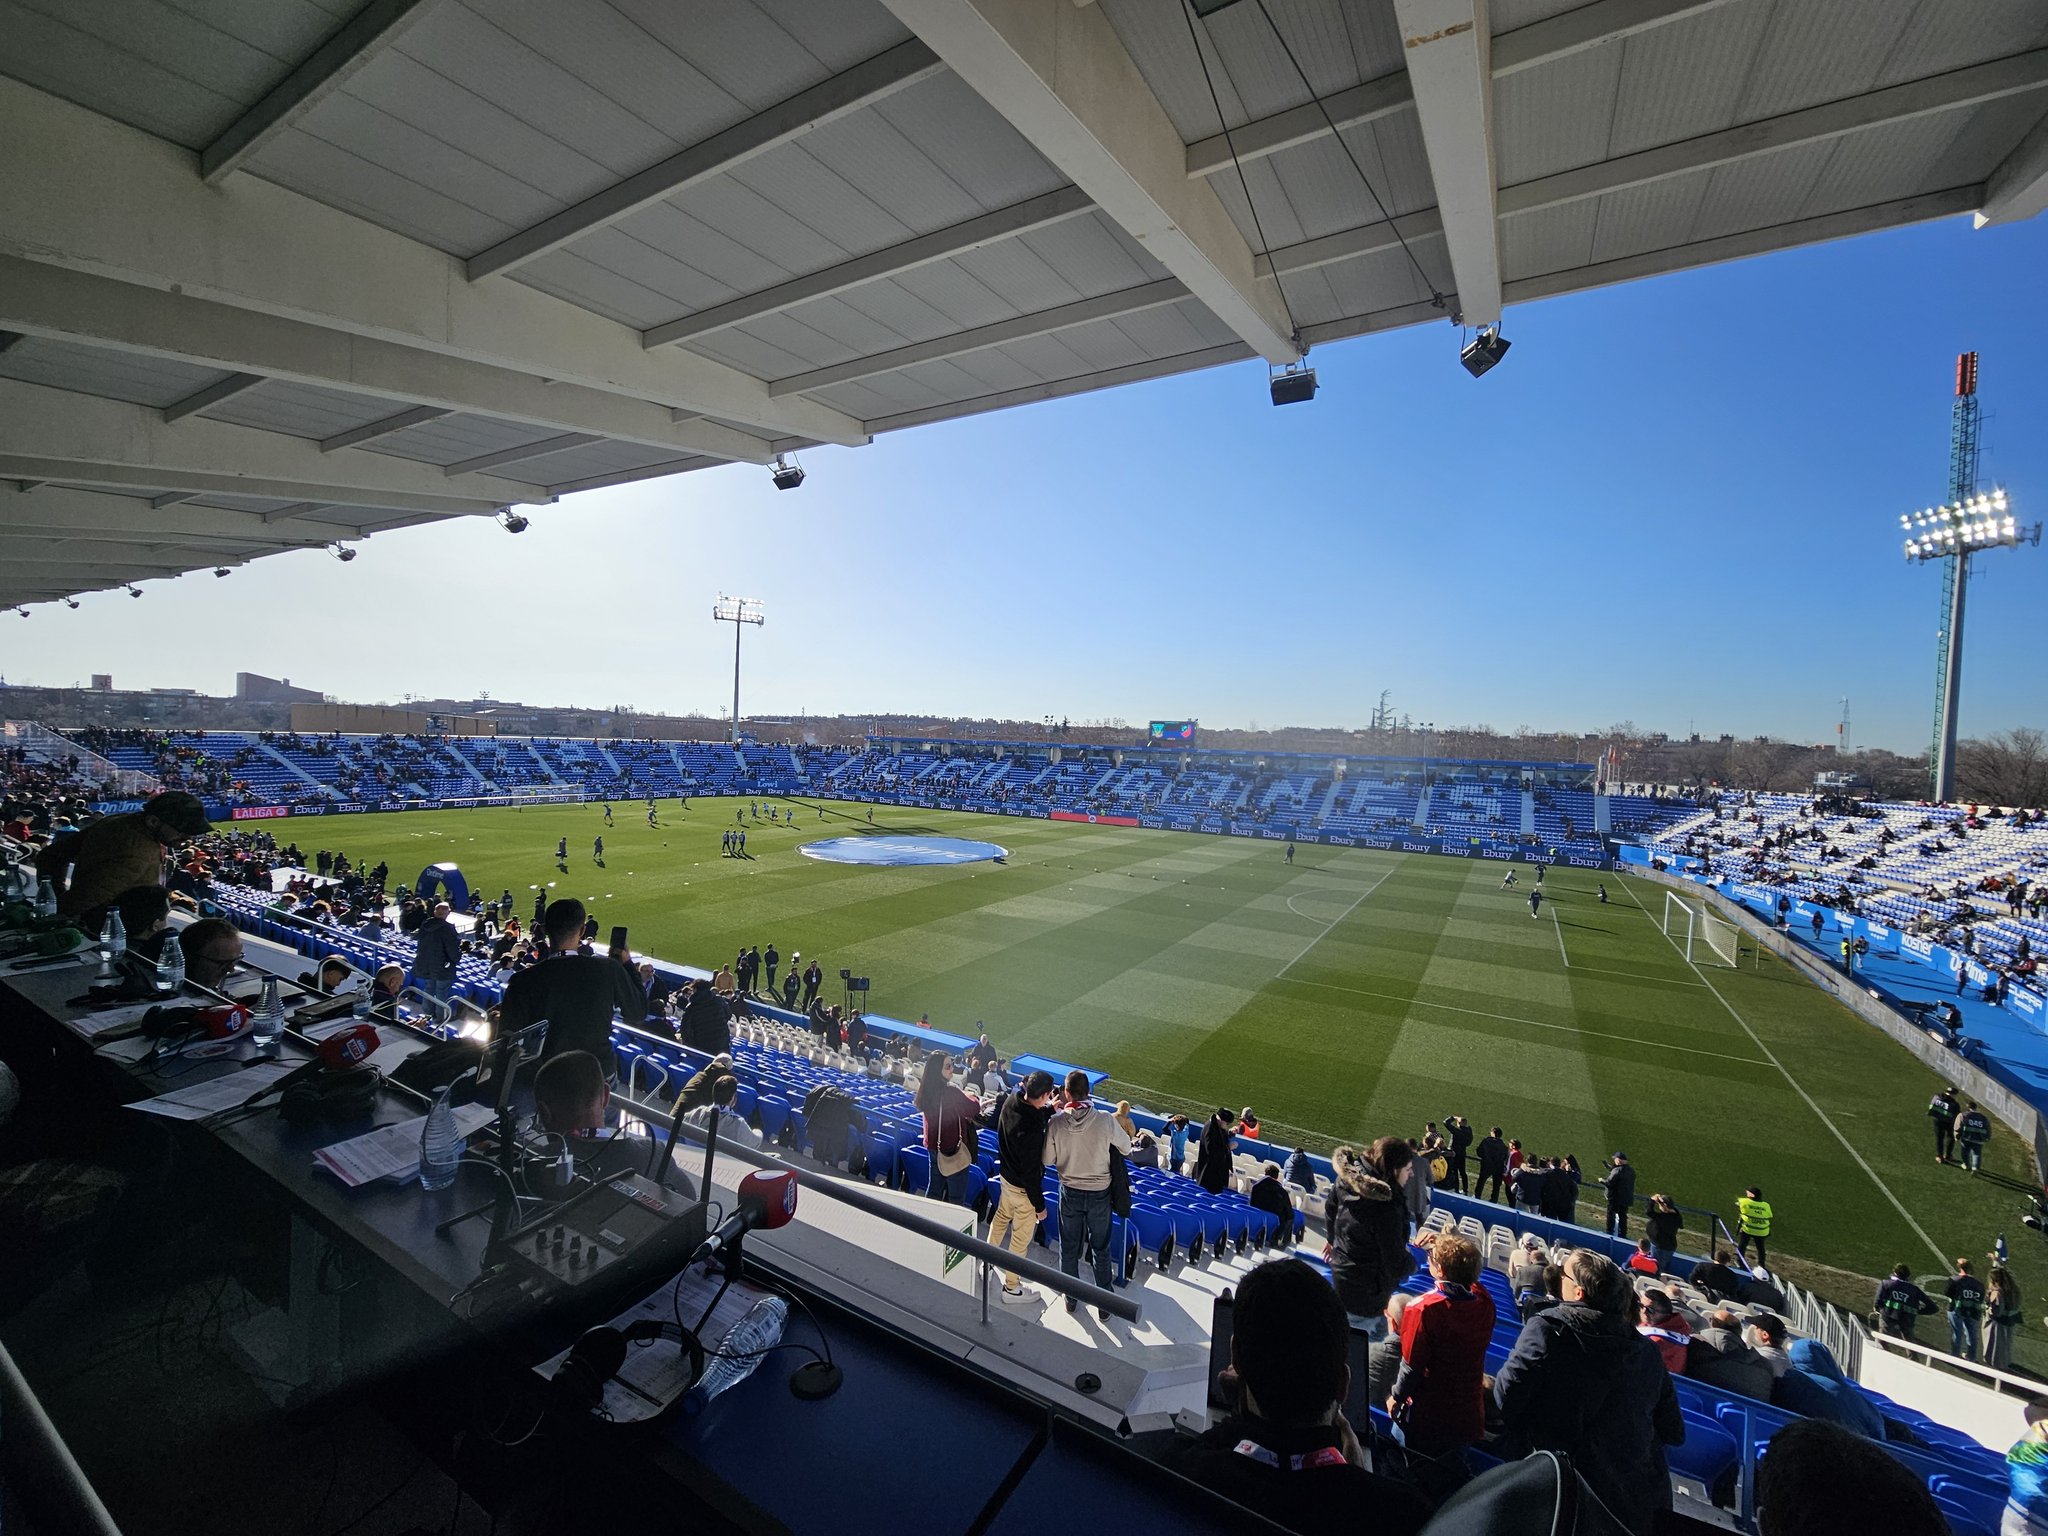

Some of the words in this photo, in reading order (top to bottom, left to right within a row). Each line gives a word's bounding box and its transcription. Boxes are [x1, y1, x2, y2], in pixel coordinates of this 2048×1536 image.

[338, 804, 367, 813] Ebury
[380, 802, 407, 810] Ebury
[418, 800, 443, 809] Ebury
[235, 808, 273, 819] LALIGA
[295, 805, 325, 815] Ebury
[1007, 808, 1023, 816] Ebury
[1030, 810, 1048, 819] Ebury
[1143, 820, 1162, 829] Ebury
[1171, 822, 1191, 831] Ebury
[1201, 825, 1222, 834] Ebury
[1231, 827, 1253, 836] Ebury
[1263, 830, 1286, 840] Ebury
[1296, 833, 1319, 843] Ebury
[1330, 835, 1355, 845] Ebury
[1366, 839, 1391, 849] Ebury
[1403, 843, 1430, 853] Ebury
[1442, 846, 1470, 857] Ebury
[1482, 849, 1512, 860] Ebury
[1525, 853, 1556, 864] Ebury
[1570, 856, 1602, 868] Ebury
[1984, 1078, 2027, 1130] Ebury
